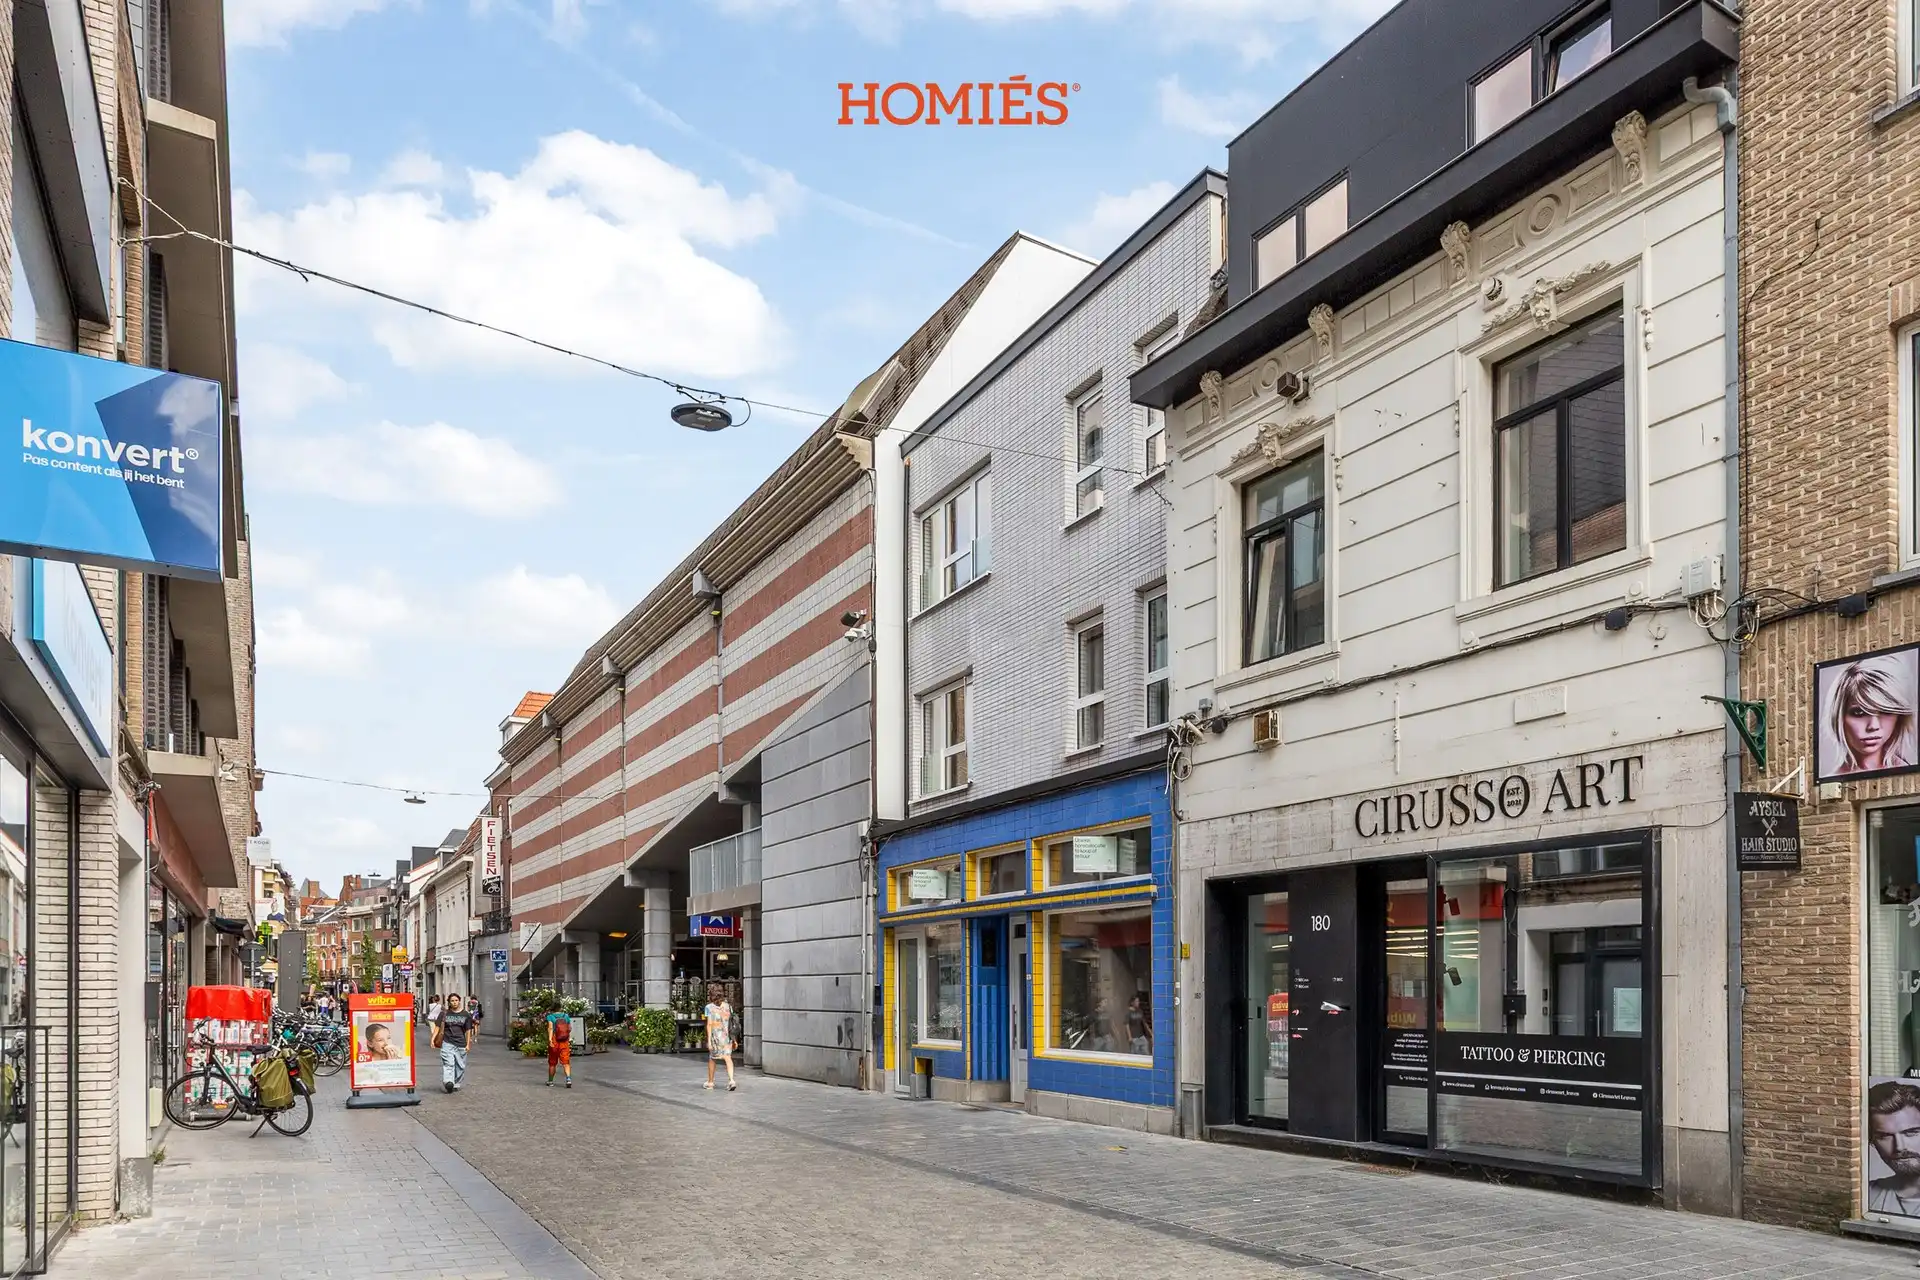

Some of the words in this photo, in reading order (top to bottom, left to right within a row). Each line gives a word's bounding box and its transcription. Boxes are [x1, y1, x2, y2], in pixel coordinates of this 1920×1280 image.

[23, 452, 49, 467] Pas
[50, 458, 103, 475] content
[104, 466, 123, 478] als
[124, 469, 133, 482] jij
[134, 470, 156, 484] het
[156, 473, 185, 489] bent
[1354, 774, 1531, 838] CIRUSSO
[1542, 755, 1644, 814] ART
[1506, 786, 1522, 797] EST.
[1748, 800, 1787, 817] AYSEL
[486, 820, 497, 876] FIETSEN
[1741, 836, 1765, 852] HAIR
[1765, 836, 1798, 852] STUDIO
[1310, 914, 1331, 932] 180
[367, 995, 396, 1005] wibra
[1460, 1045, 1514, 1062] TATTOO
[1517, 1048, 1531, 1063] &
[1533, 1048, 1606, 1067] PIERCING
